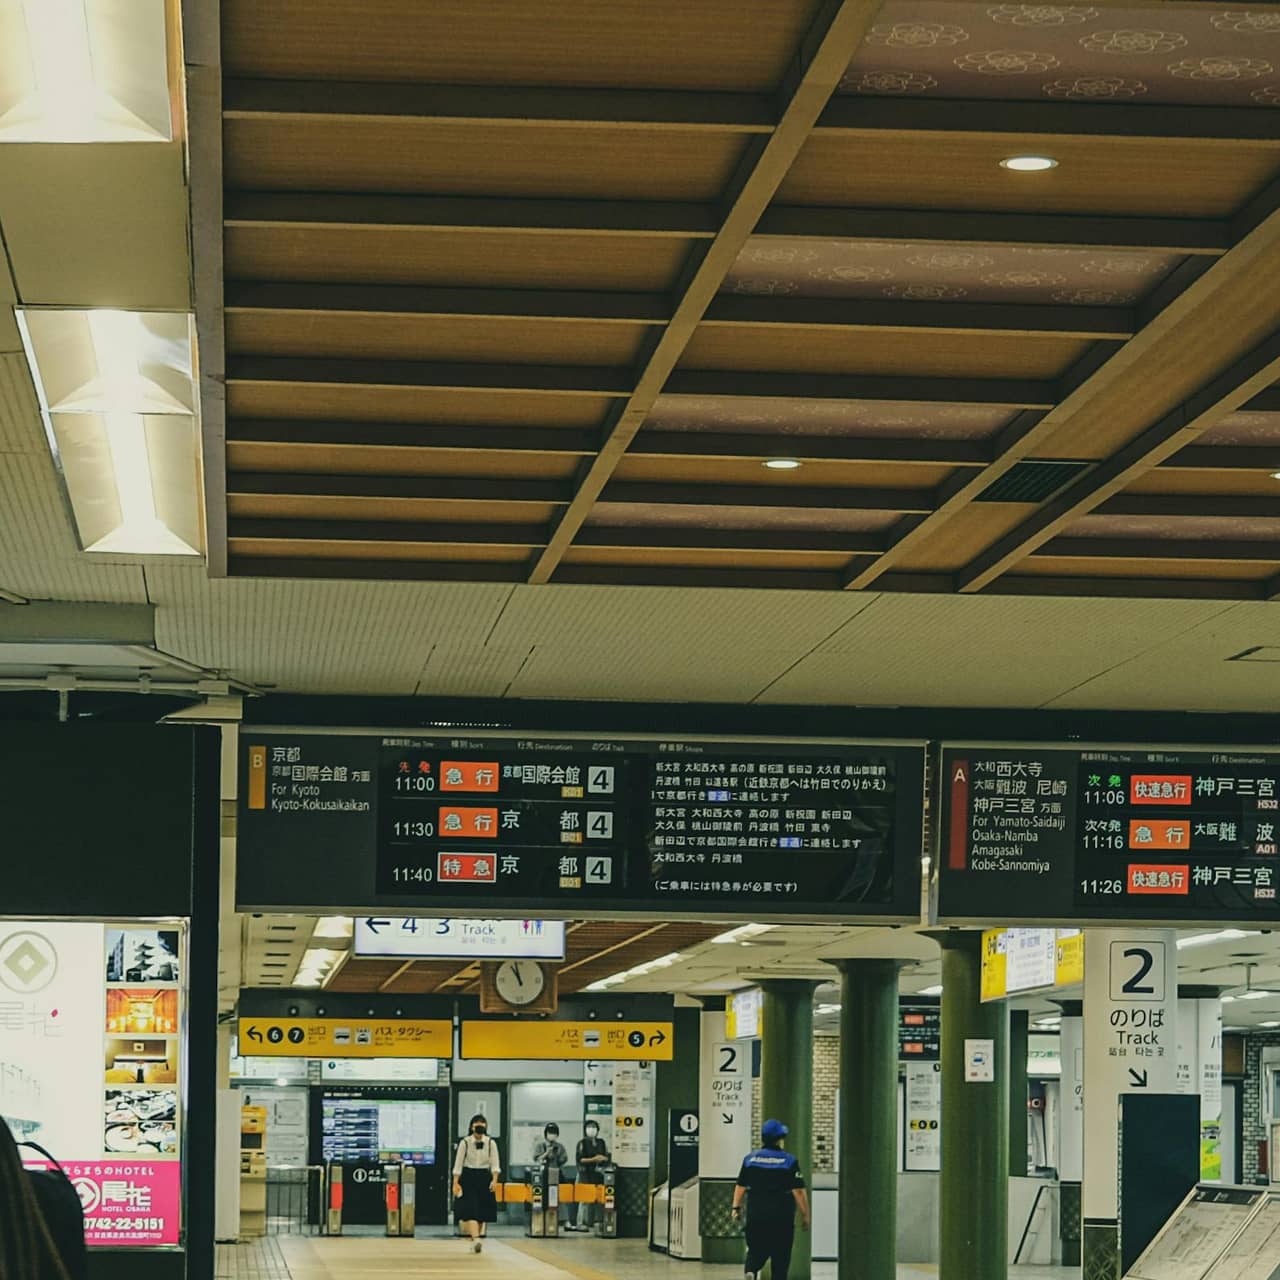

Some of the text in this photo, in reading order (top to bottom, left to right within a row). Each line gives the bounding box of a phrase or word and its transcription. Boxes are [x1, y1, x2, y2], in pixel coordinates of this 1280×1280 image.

[253, 755, 263, 768] B
[272, 747, 300, 762] 京都
[272, 766, 370, 782] 京都国際会館 方面
[445, 768, 494, 785] 急行
[503, 765, 580, 785] 京都国際会館
[954, 769, 966, 782] A
[975, 761, 1043, 777] 大和西大寺
[395, 777, 435, 791] 11:00
[592, 770, 609, 790] 4
[1088, 774, 1121, 787] 次発
[1196, 777, 1276, 796] 神戸三宮
[272, 783, 319, 798] For Kyoto
[974, 780, 1067, 796] 大阪難波 尼崎
[1135, 782, 1186, 799] 快速急行
[272, 799, 369, 812] Kyoto-Kokusaikaikan
[974, 798, 1061, 813] 神戸三宮 方面
[1084, 791, 1124, 805] 11:06
[394, 822, 434, 837] 11:30
[444, 814, 493, 831] 急行
[591, 815, 608, 835] 4
[973, 816, 1065, 830] For Yamato-Saidaiji
[1085, 820, 1121, 832] 次々発
[973, 831, 1038, 842] Osaka-Namba
[1083, 836, 1123, 849] 11:16
[1136, 827, 1184, 843] 急行
[972, 845, 1023, 859] Amagasaki
[443, 859, 491, 876] 特急
[590, 860, 607, 880] 4
[972, 859, 1049, 873] Kobe-Sannomiya
[393, 868, 432, 882] 11:40
[1132, 872, 1184, 888] 快速急行
[1193, 866, 1273, 885] 神戸三宮
[1081, 880, 1122, 893] 11:26
[462, 924, 495, 935] Track
[1122, 948, 1154, 993] 2
[1110, 1009, 1164, 1027] のりば
[561, 1029, 578, 1038] バス
[1116, 1031, 1158, 1044] Track
[720, 1048, 737, 1072] 2
[713, 1081, 742, 1090] のりば
[716, 1092, 738, 1100] Track
